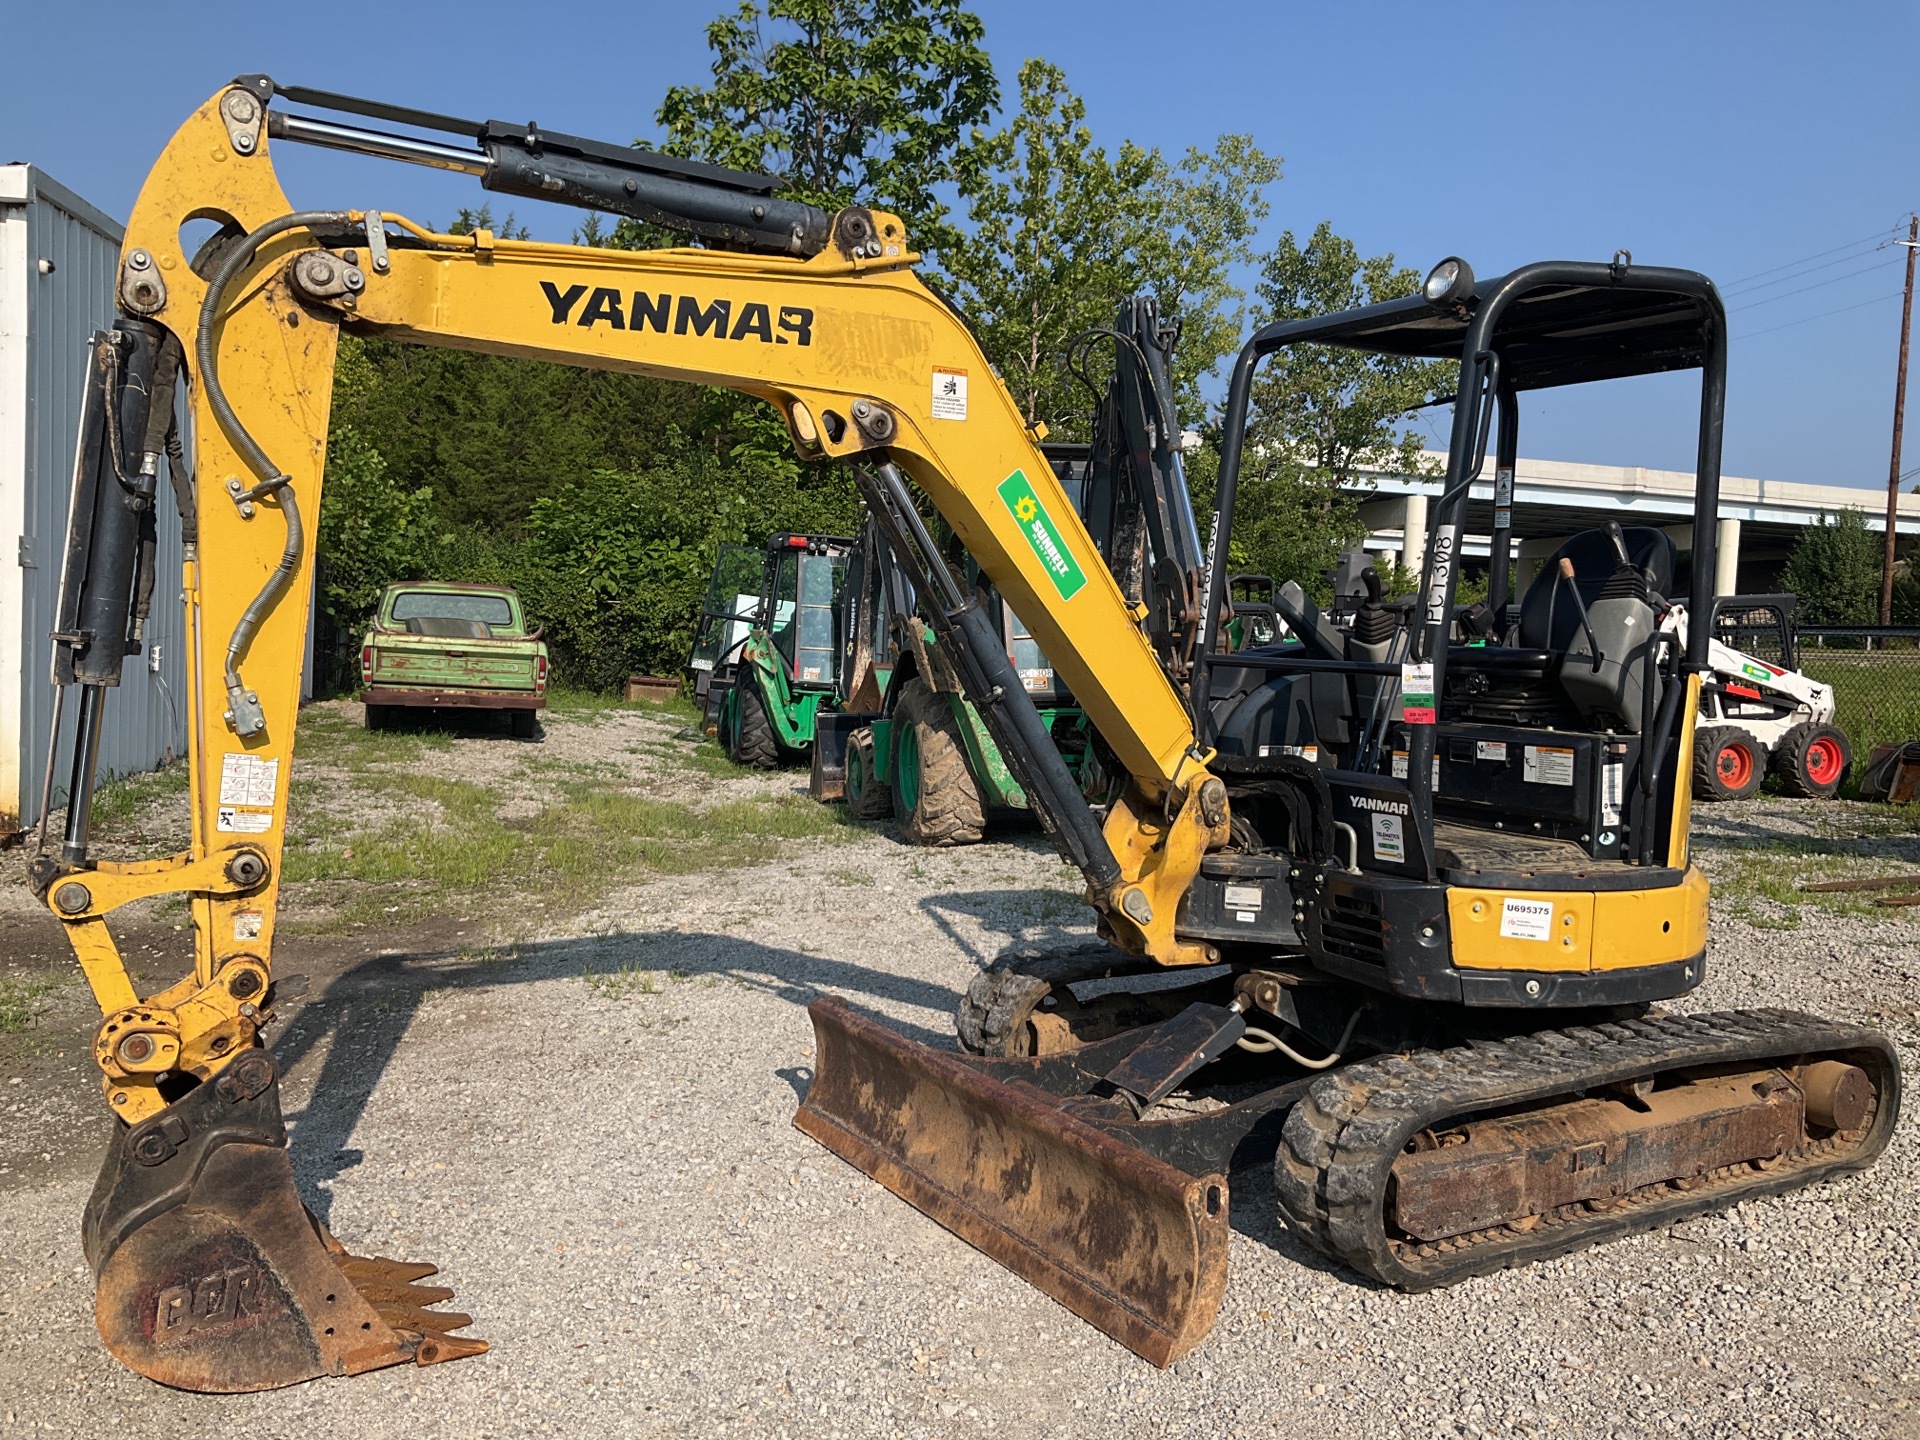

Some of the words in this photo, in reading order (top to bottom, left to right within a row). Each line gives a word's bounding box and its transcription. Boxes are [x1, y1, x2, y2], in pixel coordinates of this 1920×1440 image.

[539, 281, 814, 346] YANMAR
[1031, 519, 1069, 576] SUNBELT
[1032, 533, 1057, 573] RENTALS
[1349, 795, 1409, 816] YANMAR
[1376, 831, 1400, 840] TELEMATICS
[1507, 904, 1550, 915] U695375
